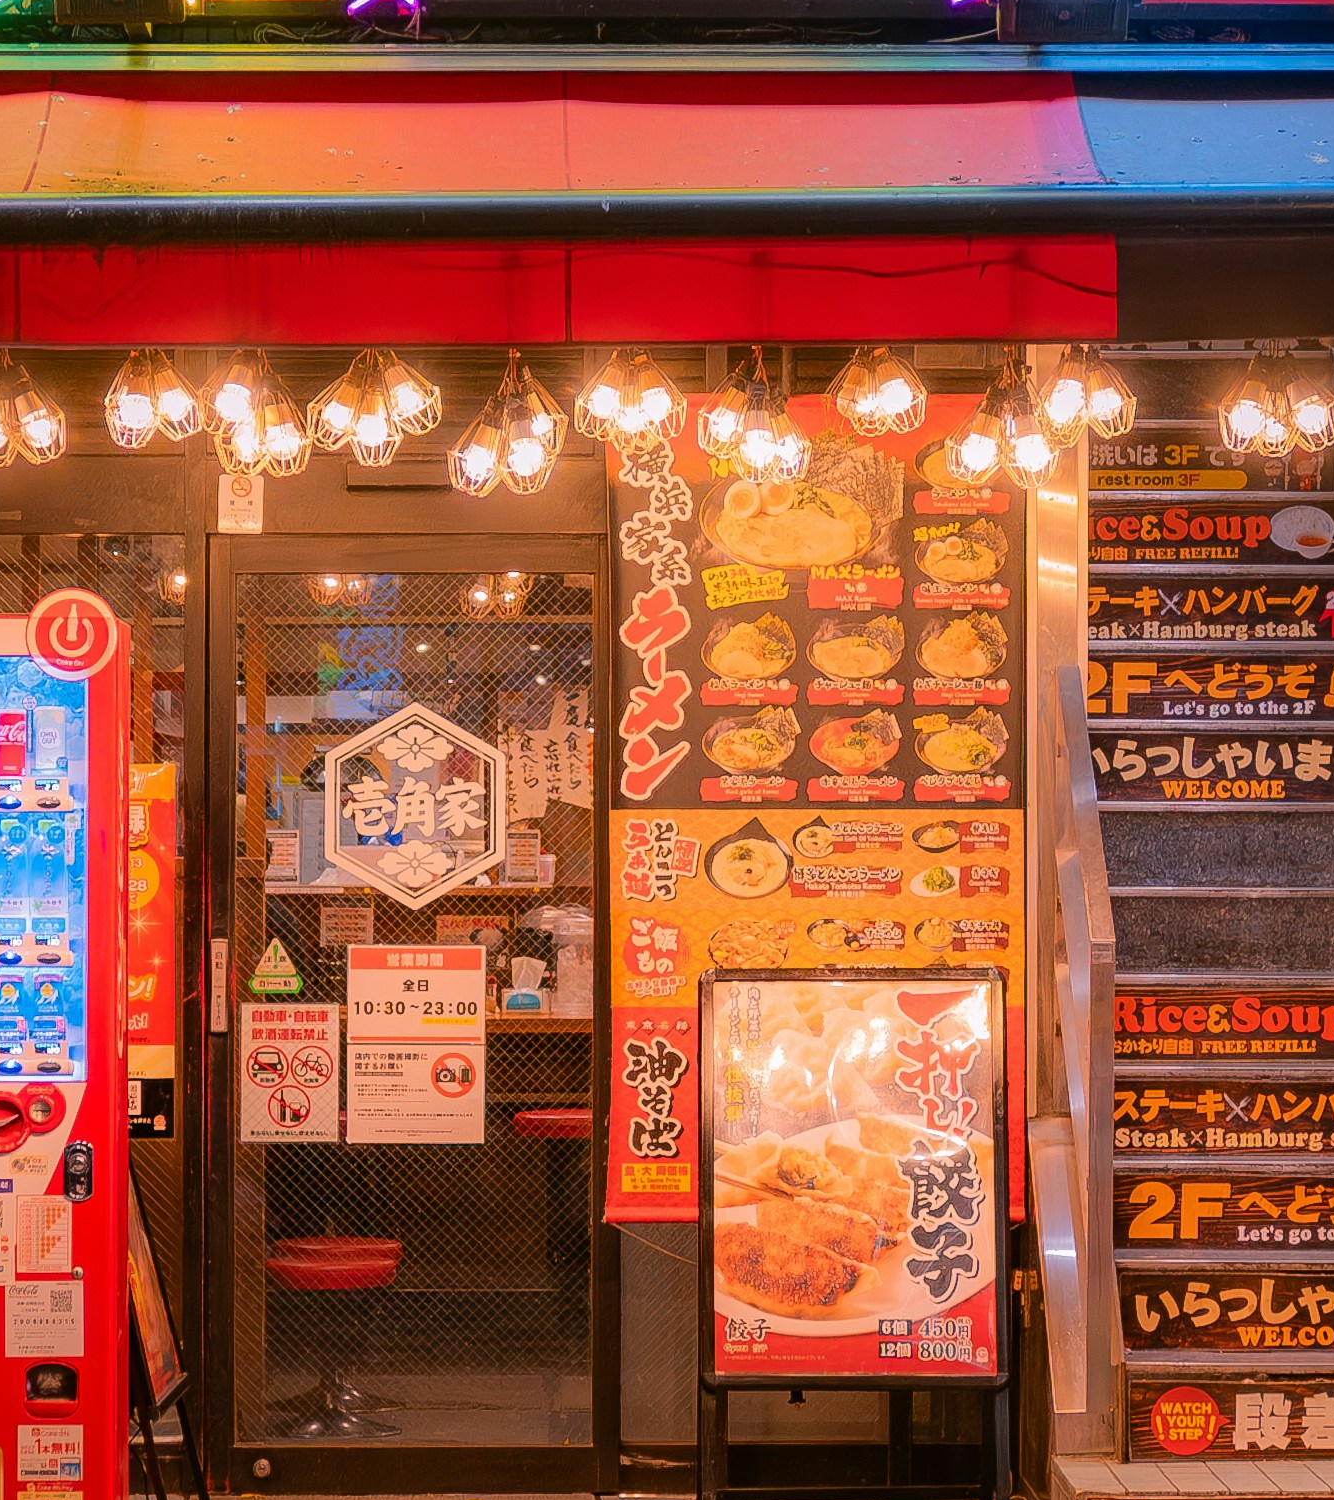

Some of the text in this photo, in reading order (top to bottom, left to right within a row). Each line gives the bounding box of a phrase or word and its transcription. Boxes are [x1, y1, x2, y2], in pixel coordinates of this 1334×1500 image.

[1097, 474, 1200, 487] rest room 3F
[1135, 547, 1239, 560] FREE REFILL!
[1183, 586, 1319, 617] ハンバーグ
[1255, 620, 1317, 638] steak
[619, 585, 689, 799] ラーメン
[1163, 700, 1316, 718] Let's go to the 2F
[1161, 780, 1286, 799] WELCOME
[343, 778, 487, 838] 壱角家
[631, 918, 679, 952] ご飯
[386, 953, 444, 967] 営業時間
[637, 951, 673, 973] もの
[402, 979, 429, 992] 全日
[252, 1028, 328, 1041] 飲酒運転禁止
[1201, 1040, 1317, 1054] FREE REFILL!
[625, 1040, 684, 1154] 油そば
[1113, 1090, 1224, 1123] ステーキ
[907, 1143, 984, 1301] 餃子
[1237, 1225, 1286, 1242] Let's
[1291, 1230, 1314, 1246] go
[727, 1318, 771, 1341] 餃子
[880, 1320, 910, 1335] 6個
[880, 1342, 912, 1357] 12個
[1159, 1402, 1213, 1415] WATCH
[1166, 1414, 1206, 1428] YOUR
[1167, 1427, 1203, 1441] STEP
